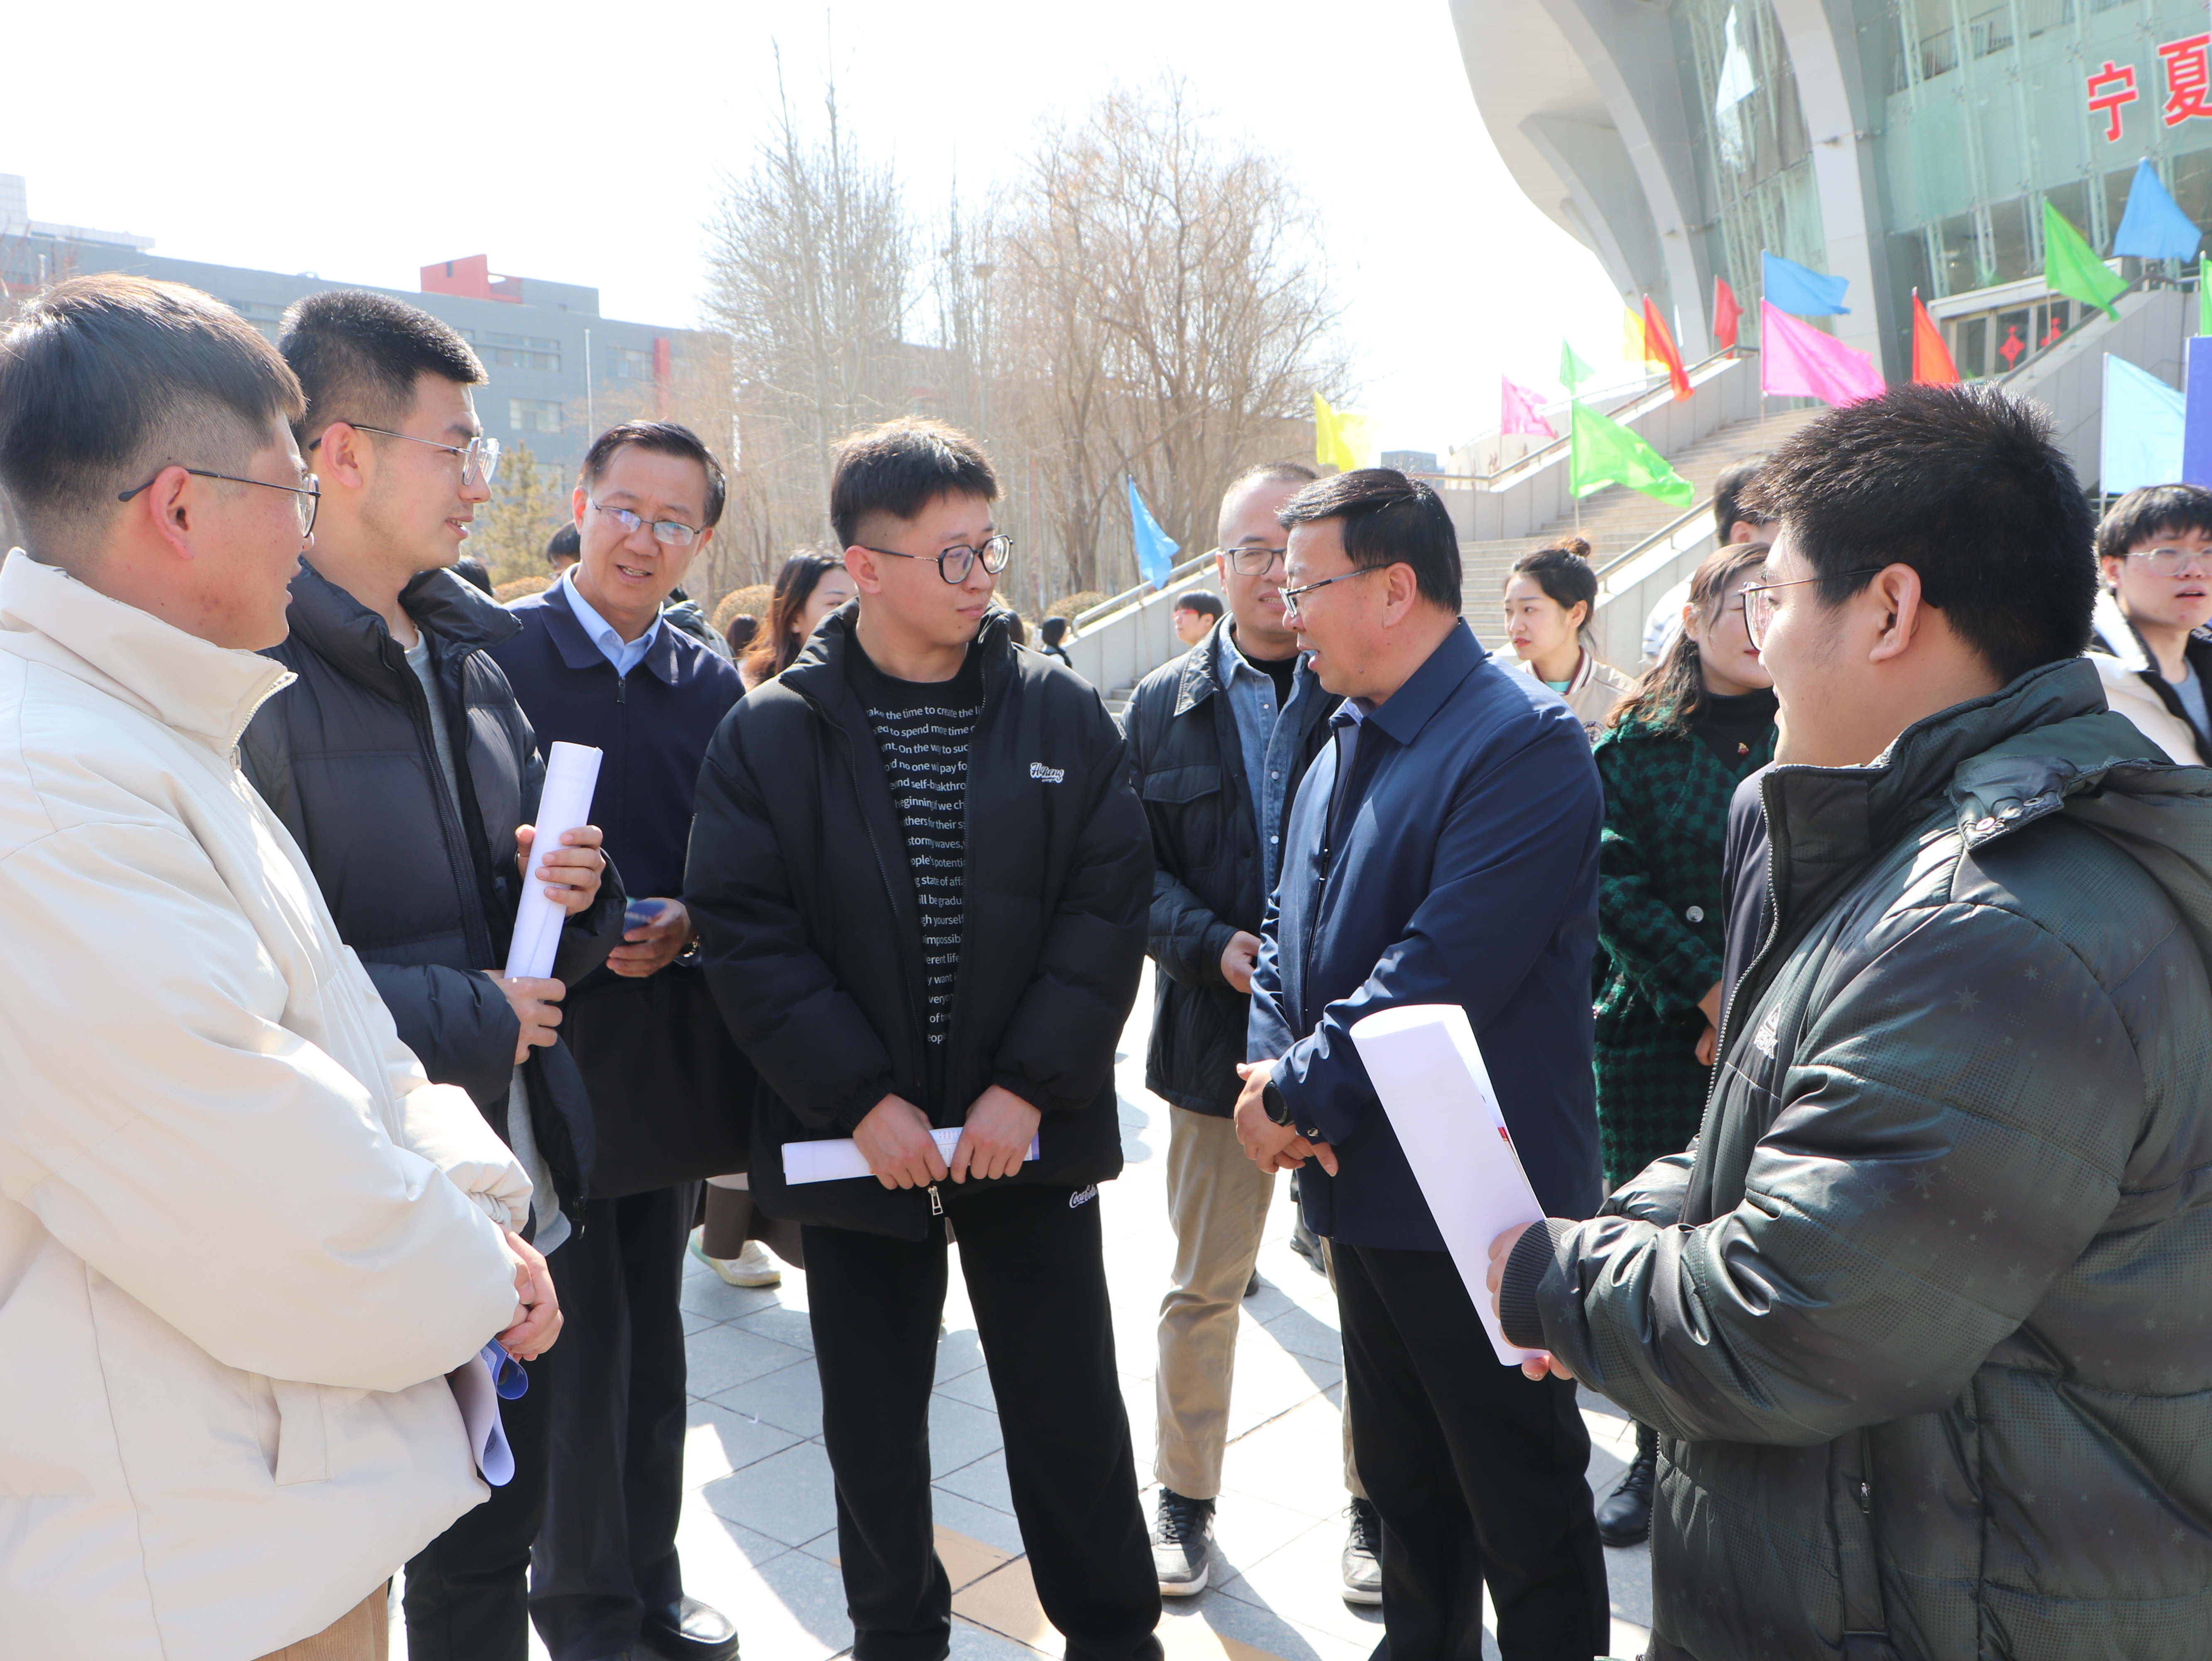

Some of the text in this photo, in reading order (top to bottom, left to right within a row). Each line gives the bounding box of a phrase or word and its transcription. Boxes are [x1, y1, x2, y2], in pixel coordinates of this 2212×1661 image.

[2086, 32, 2212, 142] 宁夏
[886, 711, 902, 719] the
[902, 708, 923, 718] time
[937, 708, 957, 718] create
[958, 709, 973, 718] the
[890, 728, 900, 736] to
[901, 723, 929, 738] spend
[931, 725, 947, 735] more
[948, 727, 969, 735] time
[898, 745, 912, 754] On
[913, 744, 929, 753] the
[930, 744, 941, 755] way
[942, 745, 952, 754] to
[899, 762, 910, 770] no
[912, 763, 930, 771] one
[940, 764, 956, 775] pay
[935, 820, 956, 829] their
[908, 836, 934, 848] stormy
[934, 841, 964, 850] waves,
[921, 875, 939, 885] state
[940, 877, 948, 886] of
[929, 894, 937, 904] be
[934, 973, 952, 984] want
[930, 1013, 940, 1023] of
